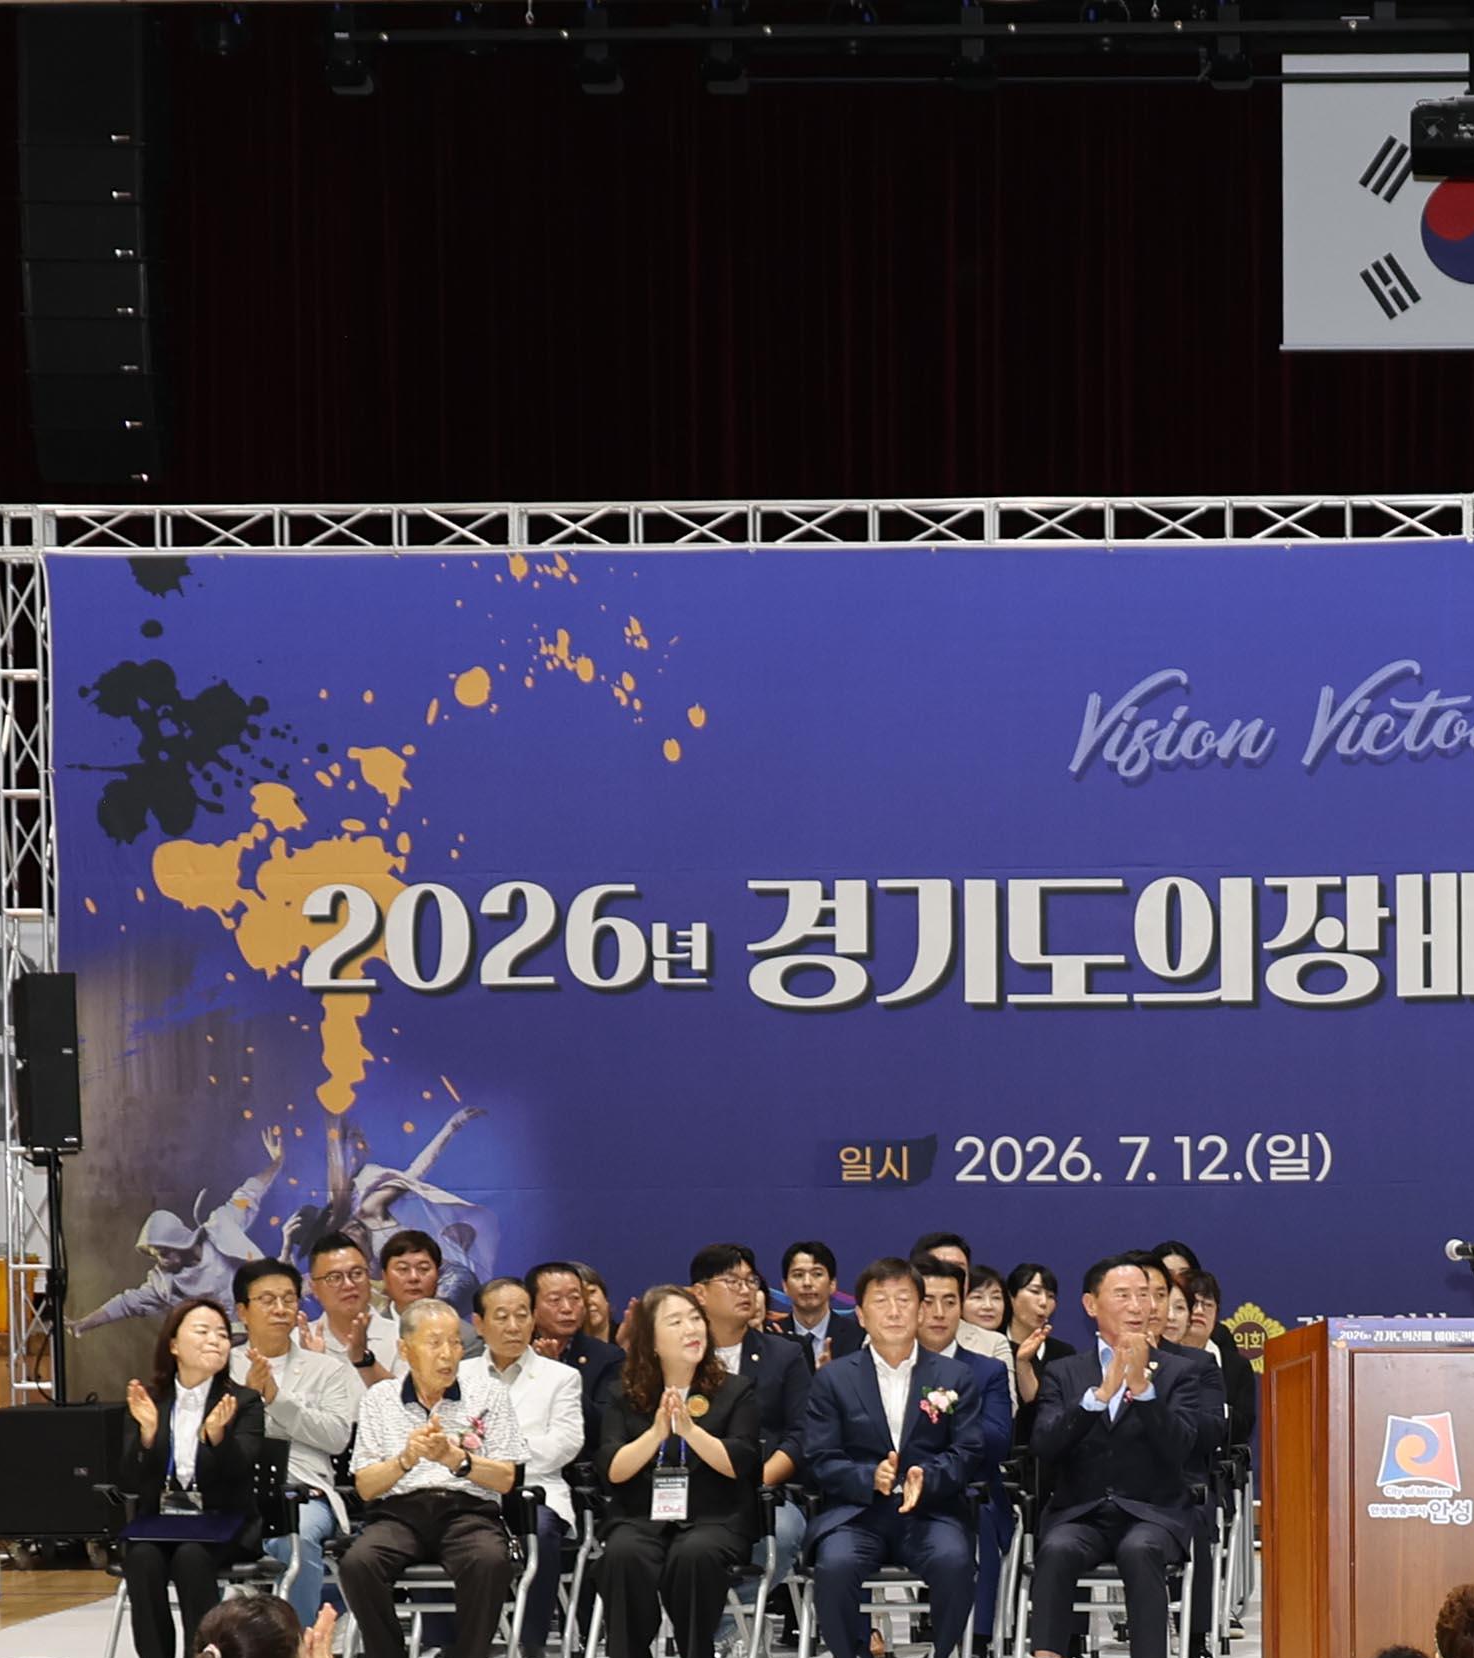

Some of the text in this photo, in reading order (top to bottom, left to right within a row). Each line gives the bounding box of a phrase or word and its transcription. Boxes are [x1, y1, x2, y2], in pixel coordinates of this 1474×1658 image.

[1069, 668, 1275, 778] Vision
[302, 881, 712, 990] 2026년
[839, 1146, 908, 1182] 일시
[955, 1136, 1102, 1182] 2026.
[1119, 1136, 1158, 1182] 7.
[1233, 1330, 1265, 1350] 의회
[1429, 1501, 1471, 1522] 안성
